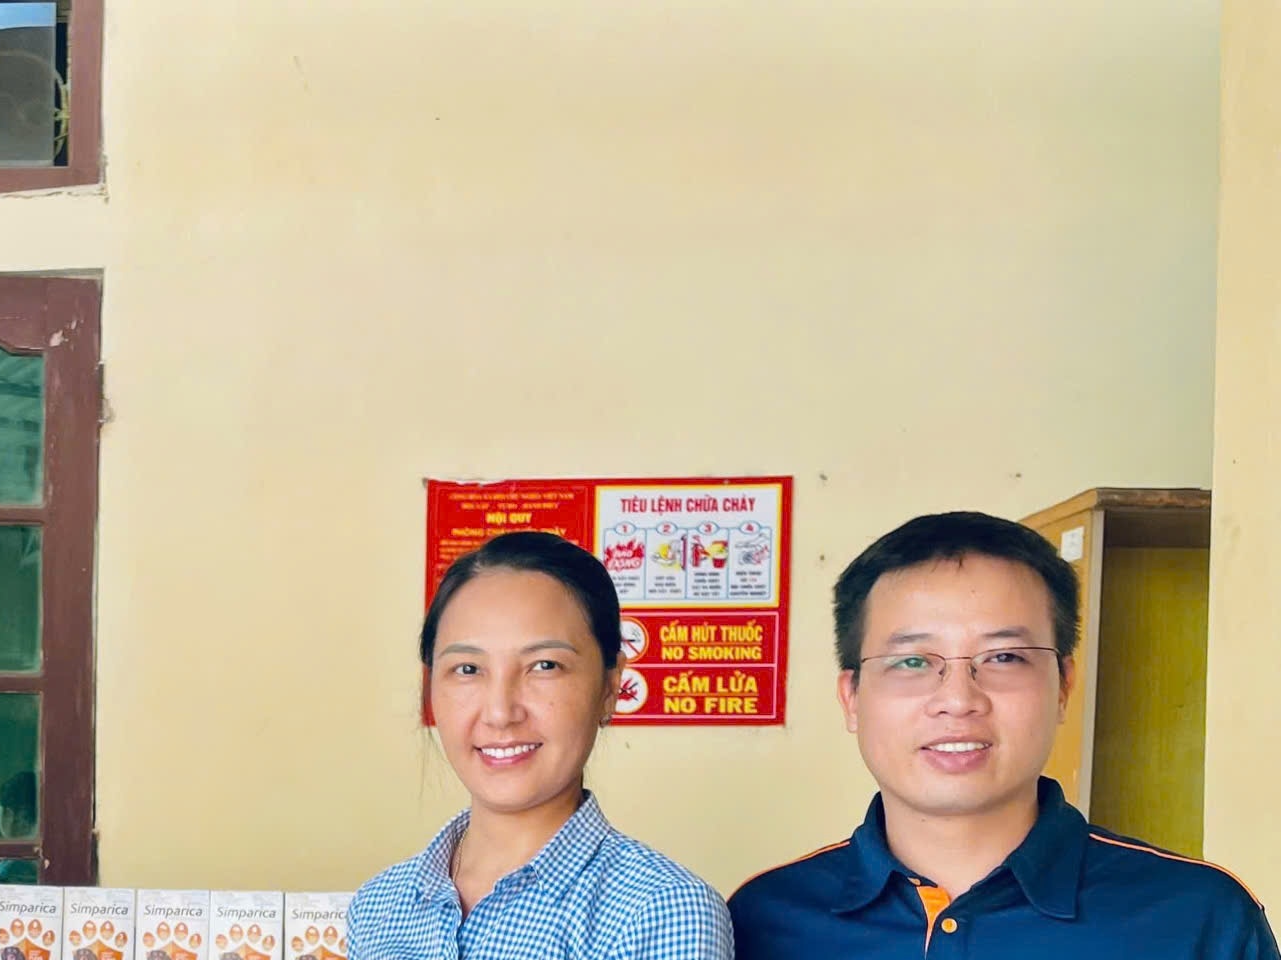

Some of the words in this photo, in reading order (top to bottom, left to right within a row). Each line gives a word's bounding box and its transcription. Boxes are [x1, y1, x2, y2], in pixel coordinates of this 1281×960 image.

[651, 494, 682, 515] LỆNH
[622, 525, 628, 533] 1
[662, 524, 671, 533] 2
[703, 524, 712, 532] 3
[745, 524, 754, 532] 4
[660, 619, 688, 642] CẤM
[691, 621, 717, 642] HÚT
[721, 619, 763, 642] THUỐC
[662, 647, 684, 660] NO
[688, 647, 762, 660] SMOKING
[663, 670, 710, 693] CẤM
[717, 670, 758, 693] LỬA
[664, 697, 697, 714] NO
[704, 697, 758, 714] FIRE
[70, 903, 129, 917] Simparica
[144, 905, 203, 919] Simparica
[216, 907, 277, 920] Simparica
